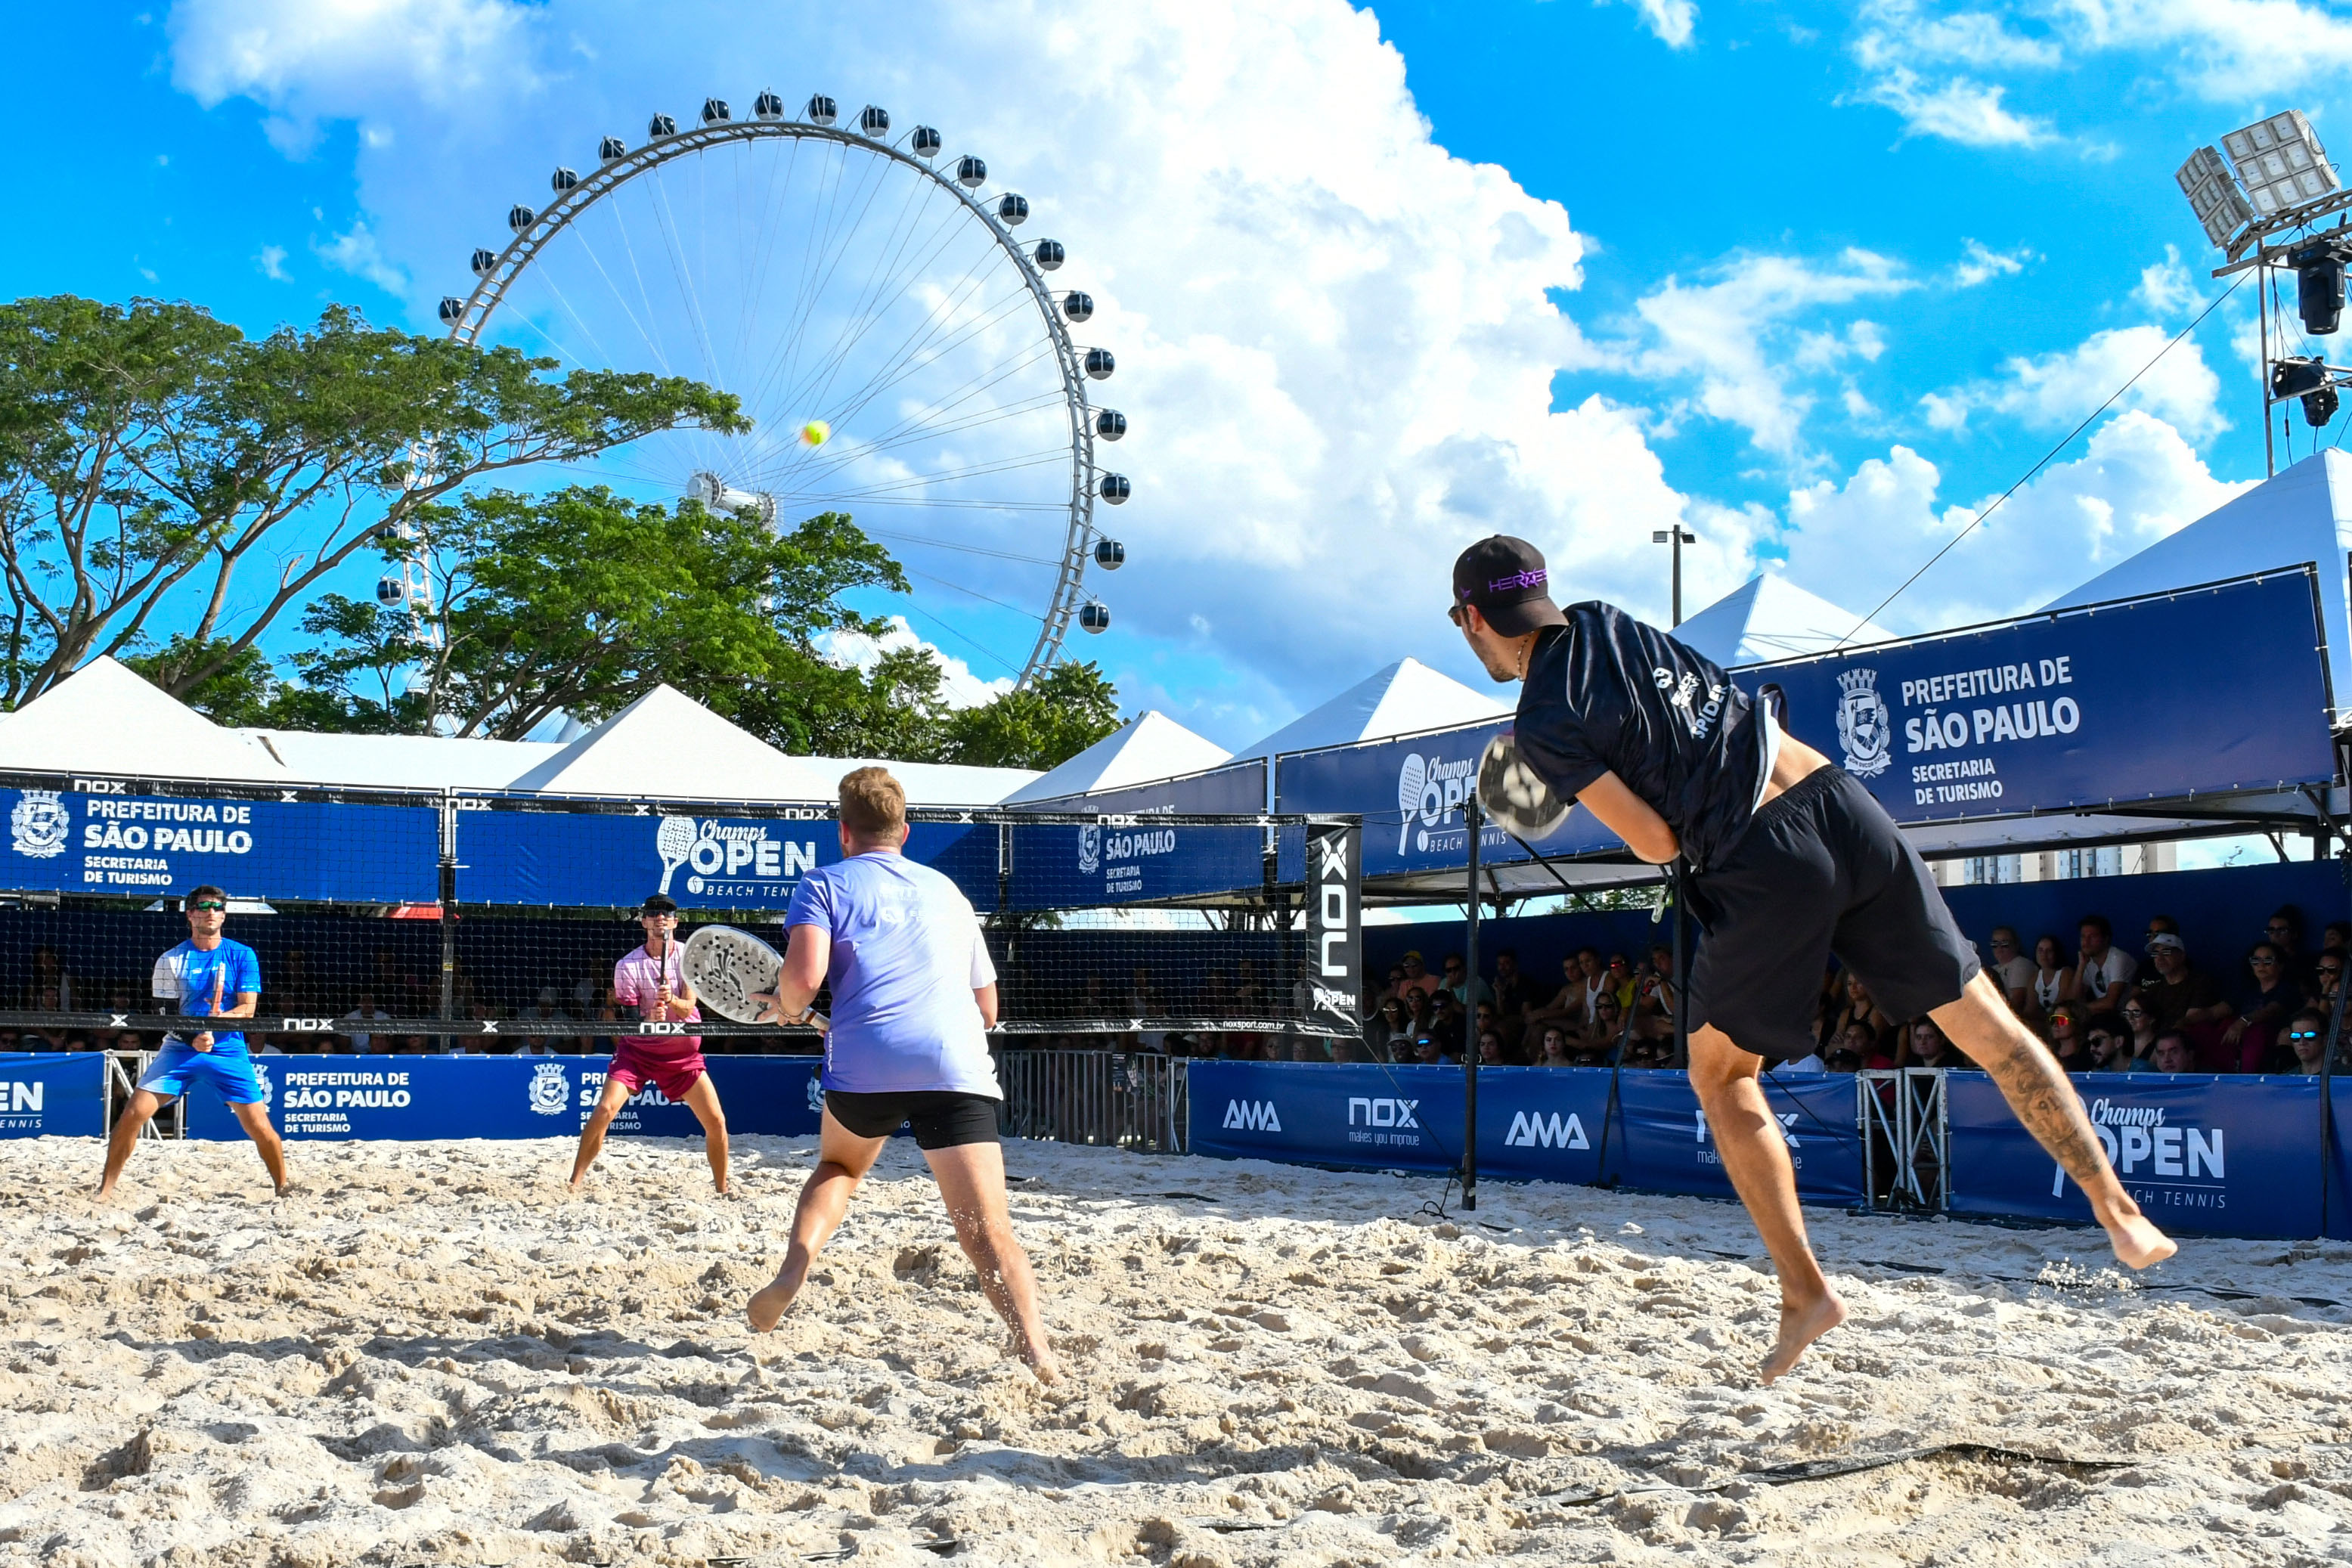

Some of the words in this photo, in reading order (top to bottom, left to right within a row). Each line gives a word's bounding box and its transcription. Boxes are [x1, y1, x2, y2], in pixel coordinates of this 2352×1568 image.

[1671, 671, 1694, 706] BEACH
[1901, 662, 2036, 706] PREFEITURA
[2039, 655, 2072, 686] DE
[1691, 684, 1728, 739] SPIDER
[1905, 708, 1969, 753] SÃO
[1972, 696, 2080, 745] PAULO
[1427, 756, 1473, 782] Champs
[1912, 758, 1996, 783] SECRETARIA
[1915, 788, 1934, 805] DE
[1936, 780, 2003, 803] TURISMO
[87, 800, 218, 822] PREFEITURA
[222, 806, 251, 823] DE
[84, 820, 148, 850] SÃO
[153, 827, 253, 854] PAULO
[699, 819, 767, 848] Champs
[1430, 836, 1463, 852] BEACH
[1480, 831, 1507, 848] NNIS
[1106, 832, 1133, 860] SÃO
[1134, 829, 1176, 857] PAULO
[85, 856, 169, 870] SECRETARIA
[689, 839, 816, 876] OPEN
[85, 870, 104, 883] DE
[107, 872, 172, 885] TURISMO
[1106, 866, 1141, 879] SECRETARIA
[706, 885, 755, 896] BEACH
[1106, 882, 1114, 894] DE
[1115, 879, 1142, 893] TURISMO
[1323, 995, 1356, 1006] OPEN
[1222, 1021, 1285, 1030] noxsport.com.br
[286, 1073, 384, 1086] PREFEITURA
[387, 1073, 409, 1086] DE
[284, 1087, 332, 1108] SÃO
[336, 1090, 411, 1108] PAULO
[580, 1086, 603, 1106] SÃ
[0, 1120, 42, 1128] ENNIS
[284, 1113, 347, 1122] SECRETARIA
[1222, 1099, 1281, 1132] AMA
[2090, 1098, 2165, 1134] Champs
[284, 1123, 299, 1133] DE
[302, 1123, 351, 1133] TURISMO
[1504, 1111, 1590, 1149] AMA
[1349, 1130, 1371, 1142] makes
[1374, 1133, 1387, 1146] you
[1390, 1132, 1419, 1148] improve
[1697, 1149, 1721, 1165] mak
[2164, 1191, 2226, 1208] TENNIS
